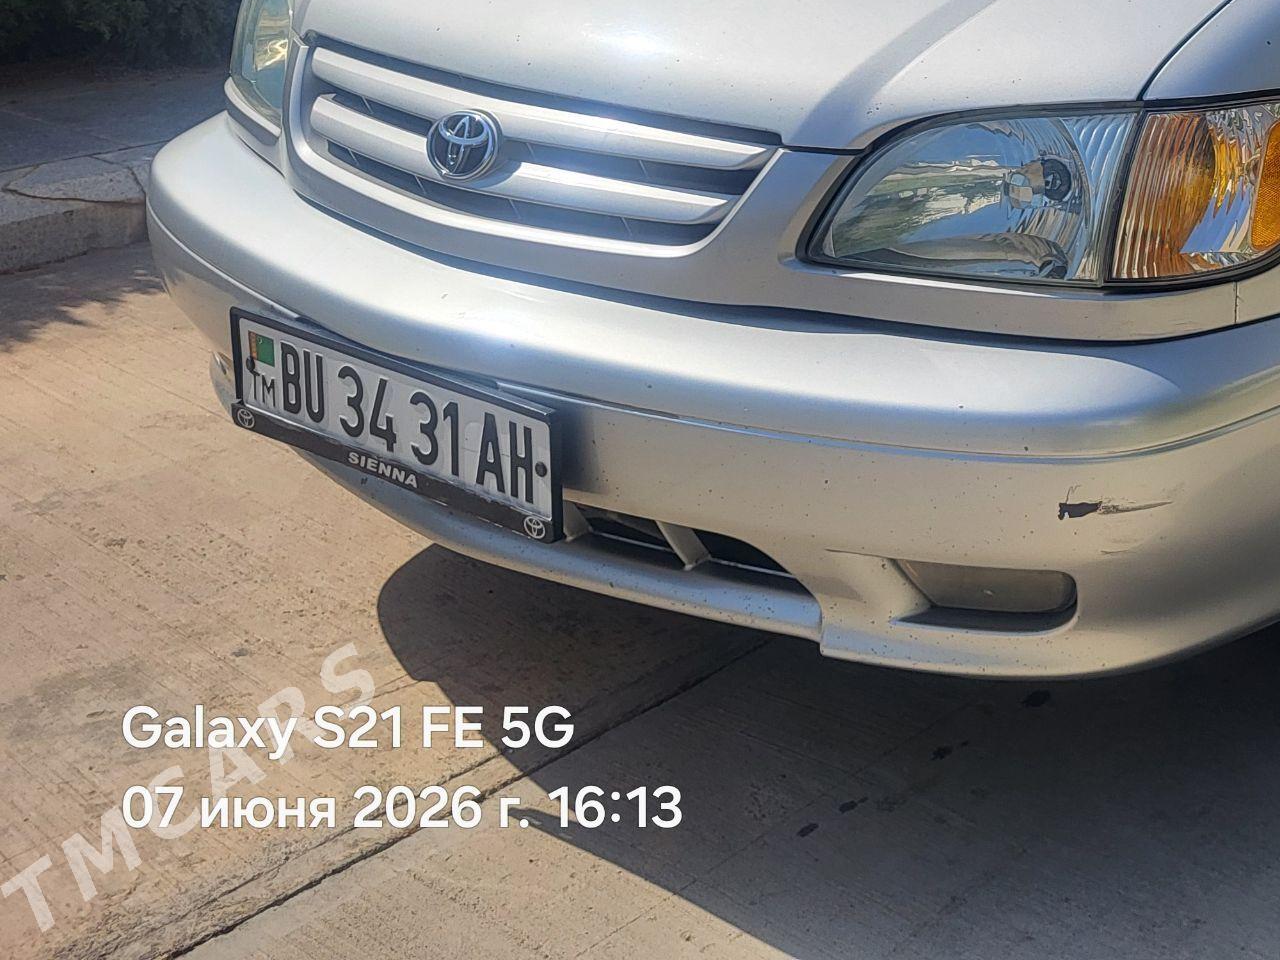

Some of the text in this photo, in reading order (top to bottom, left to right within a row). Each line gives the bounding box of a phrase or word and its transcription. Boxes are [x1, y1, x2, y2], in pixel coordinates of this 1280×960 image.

[251, 369, 277, 410] TM
[281, 342, 533, 503] BU 34 31 AH
[347, 451, 418, 489] SIENNA
